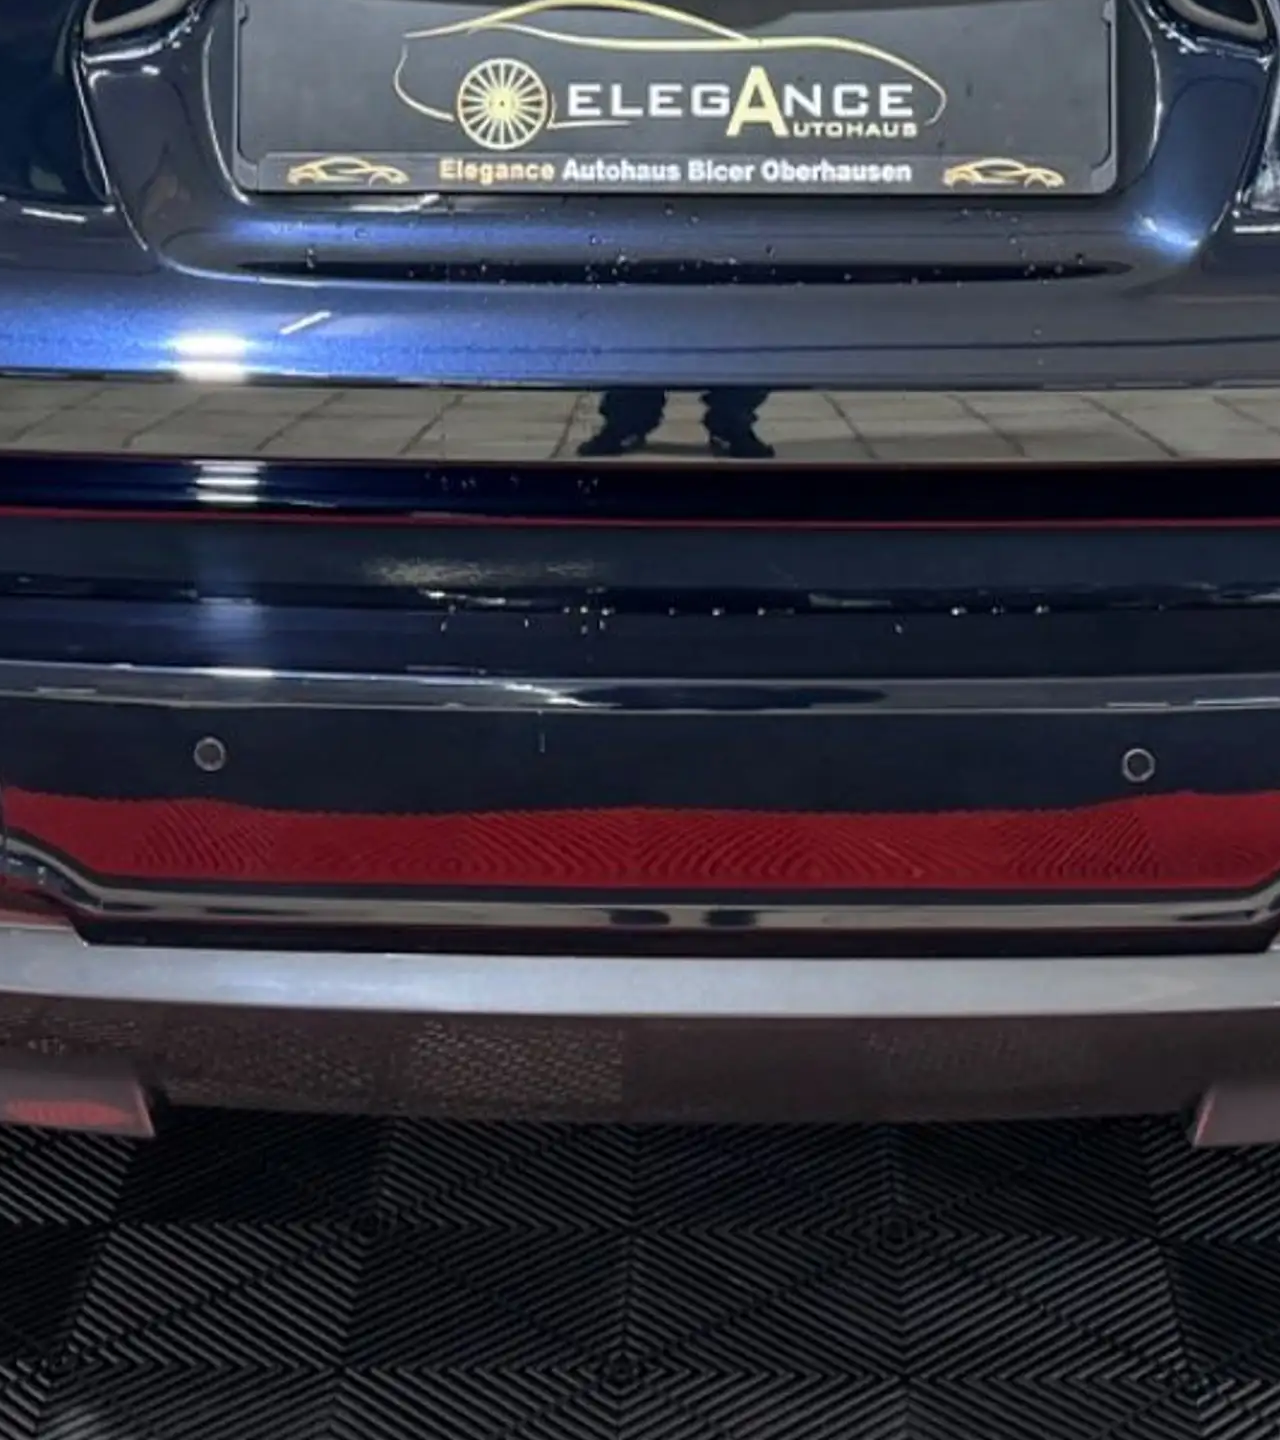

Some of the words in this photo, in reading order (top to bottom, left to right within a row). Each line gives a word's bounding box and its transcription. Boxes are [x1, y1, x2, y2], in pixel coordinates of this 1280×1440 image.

[567, 65, 914, 138] ELEGANCE
[439, 160, 555, 184] Elegance
[562, 159, 682, 182] Autohaus
[688, 160, 755, 182] Bicer
[761, 160, 913, 182] Oberhausen
